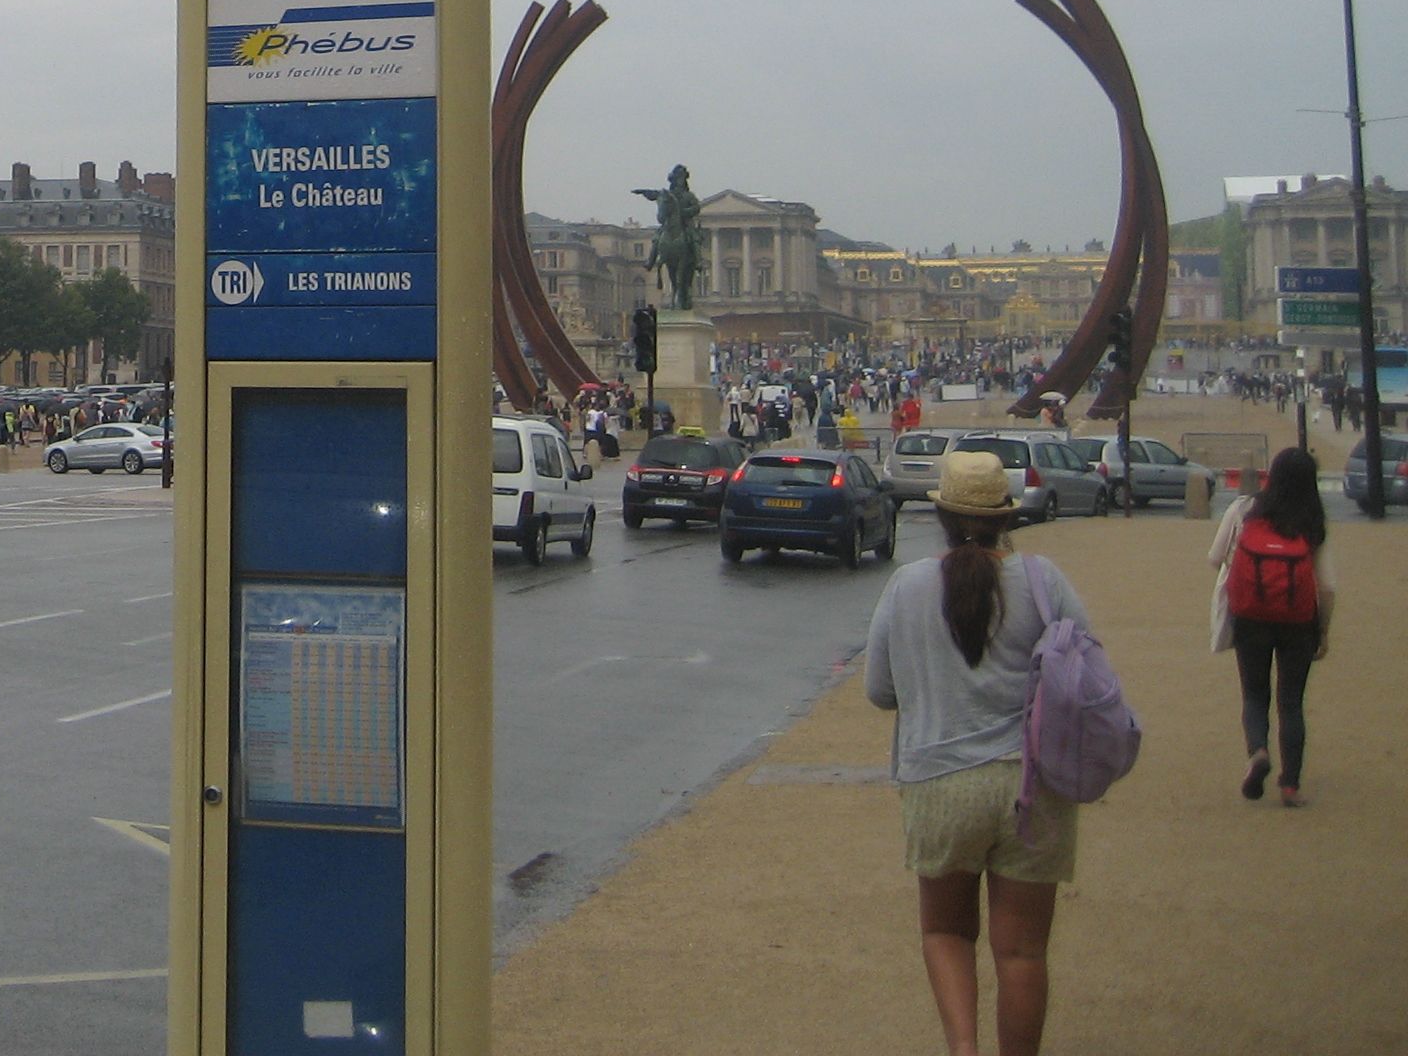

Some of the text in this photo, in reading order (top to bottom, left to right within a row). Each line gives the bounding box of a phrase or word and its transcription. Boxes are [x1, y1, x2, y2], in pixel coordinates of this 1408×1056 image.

[256, 31, 417, 56] Phébus
[247, 63, 404, 80] vous facilite la ville
[251, 144, 391, 173] VERSAILLES
[259, 182, 384, 208] Le Château
[217, 270, 248, 295] TRI
[288, 271, 412, 292] LES TRIANONS
